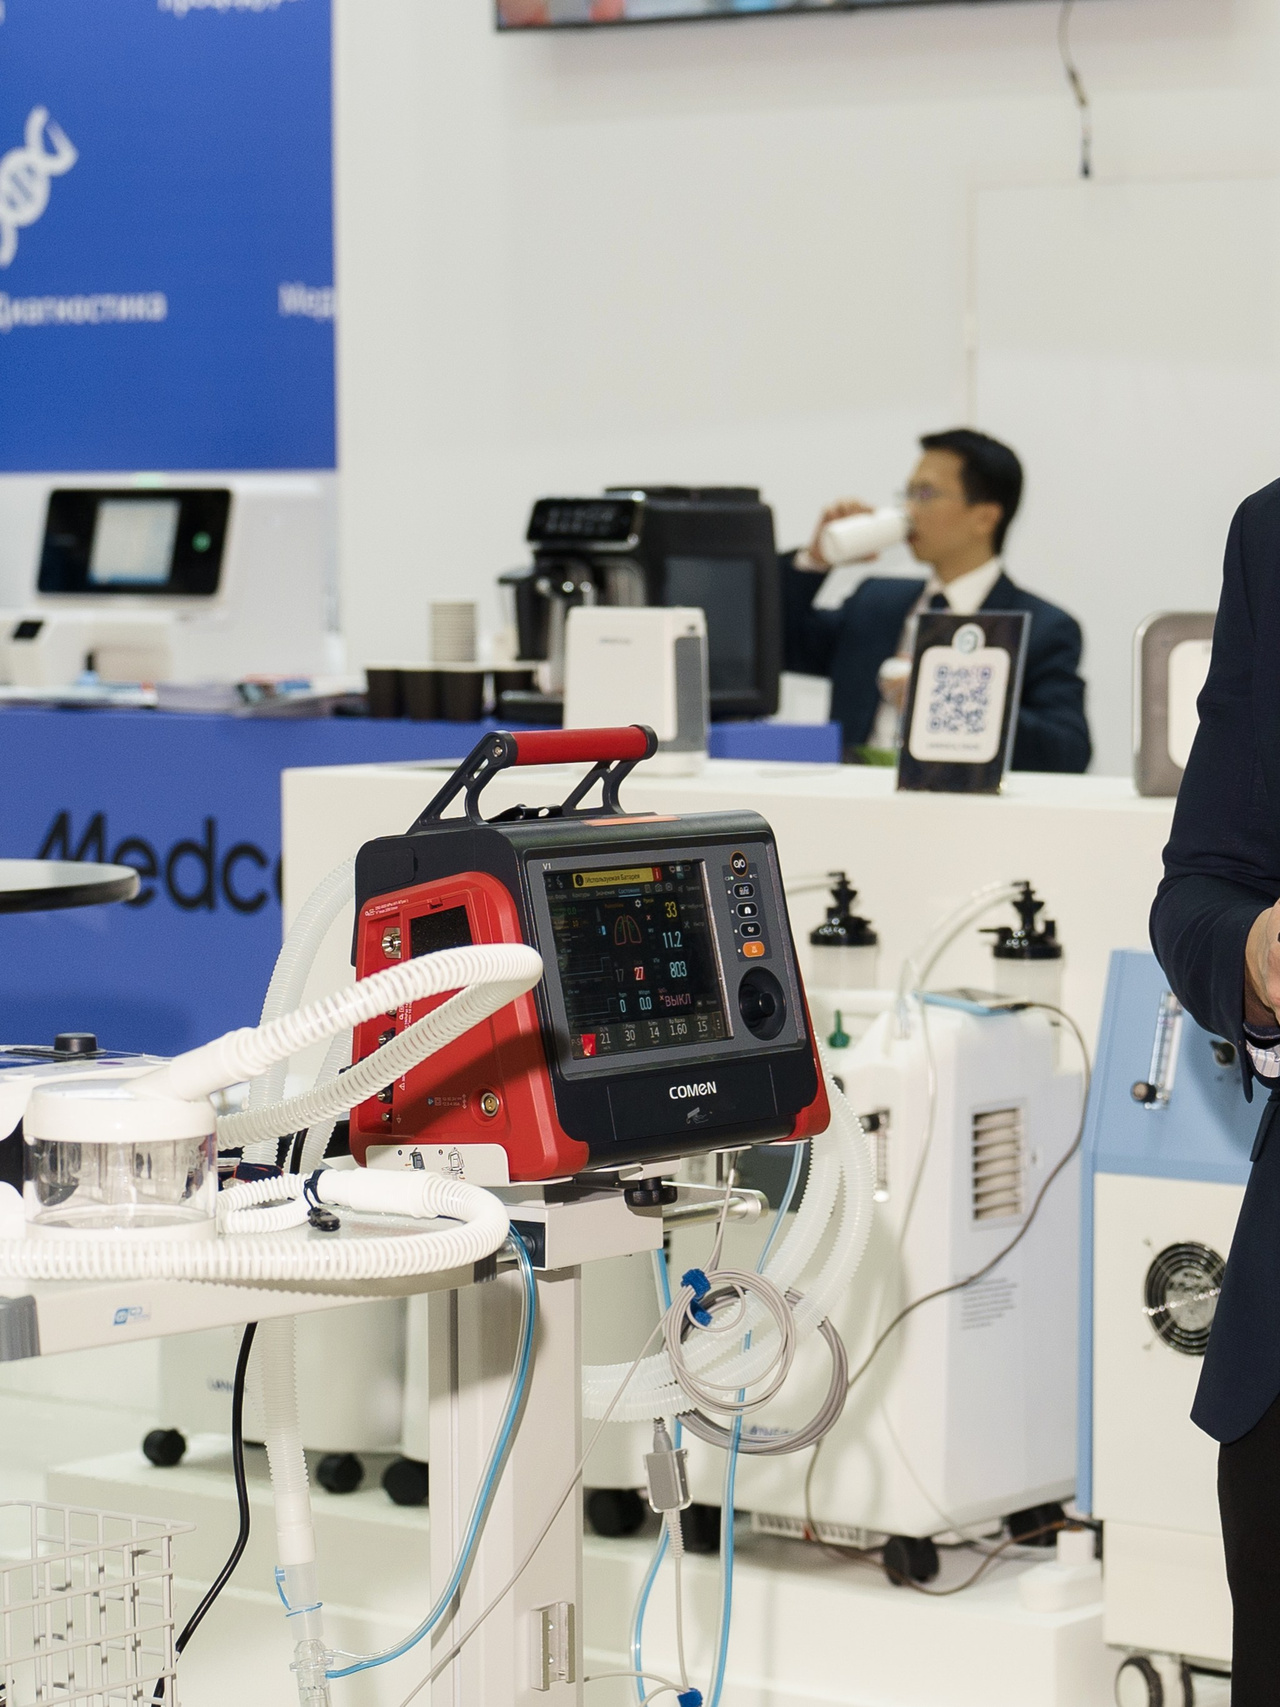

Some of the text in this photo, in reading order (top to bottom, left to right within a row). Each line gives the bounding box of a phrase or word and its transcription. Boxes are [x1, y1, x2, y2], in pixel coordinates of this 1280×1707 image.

[36, 809, 284, 914] Medc
[664, 901, 678, 918] 33
[662, 930, 683, 949] 11.2
[669, 960, 687, 978] 803
[664, 993, 692, 1008] ВЫКЛ
[650, 1026, 660, 1039] 14
[670, 1022, 688, 1036] 1.60
[697, 1020, 708, 1032] 15
[599, 1032, 611, 1045] 21
[624, 1029, 636, 1042] 30
